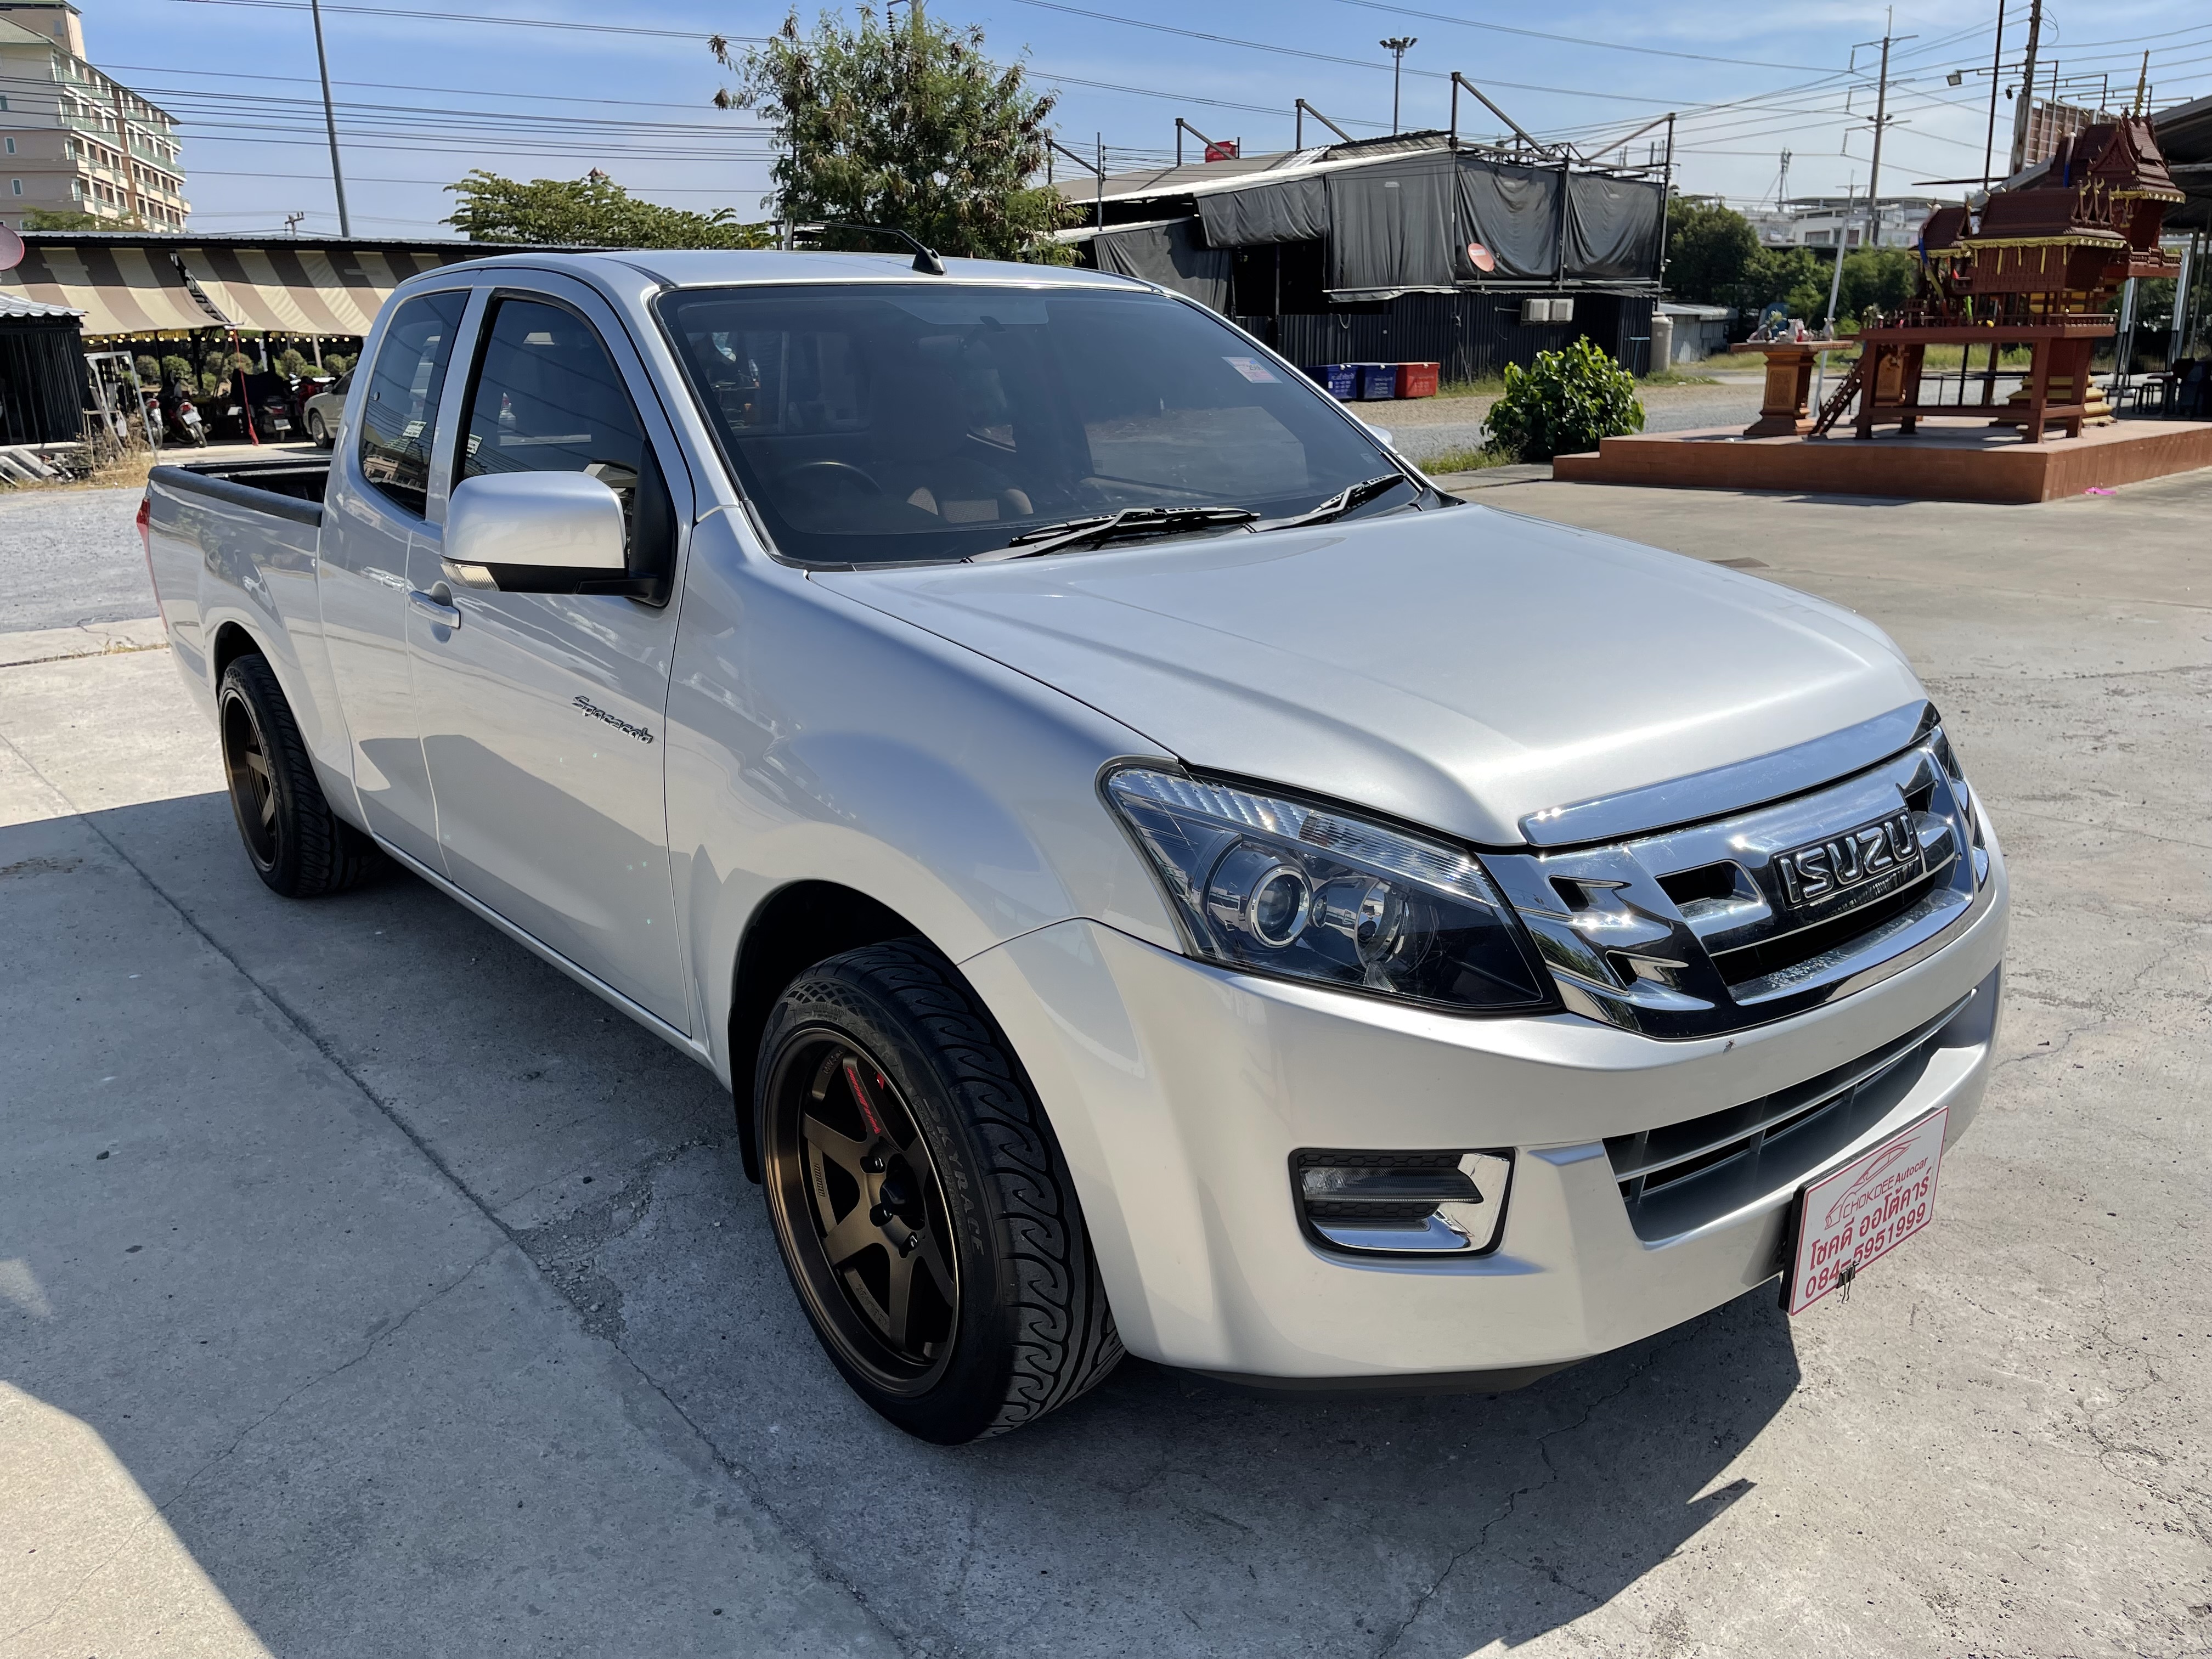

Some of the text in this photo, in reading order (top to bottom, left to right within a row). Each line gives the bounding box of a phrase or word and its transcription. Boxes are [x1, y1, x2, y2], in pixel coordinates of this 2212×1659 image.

[572, 695, 653, 744] Spacecab
[1780, 815, 1918, 904] ISUZU
[922, 1096, 985, 1256] SKYRACE
[1843, 1156, 1929, 1219] CHOKDEE Autocar
[1805, 1201, 1927, 1299] 084-5951999
[1810, 1216, 1855, 1271] โชคดี
